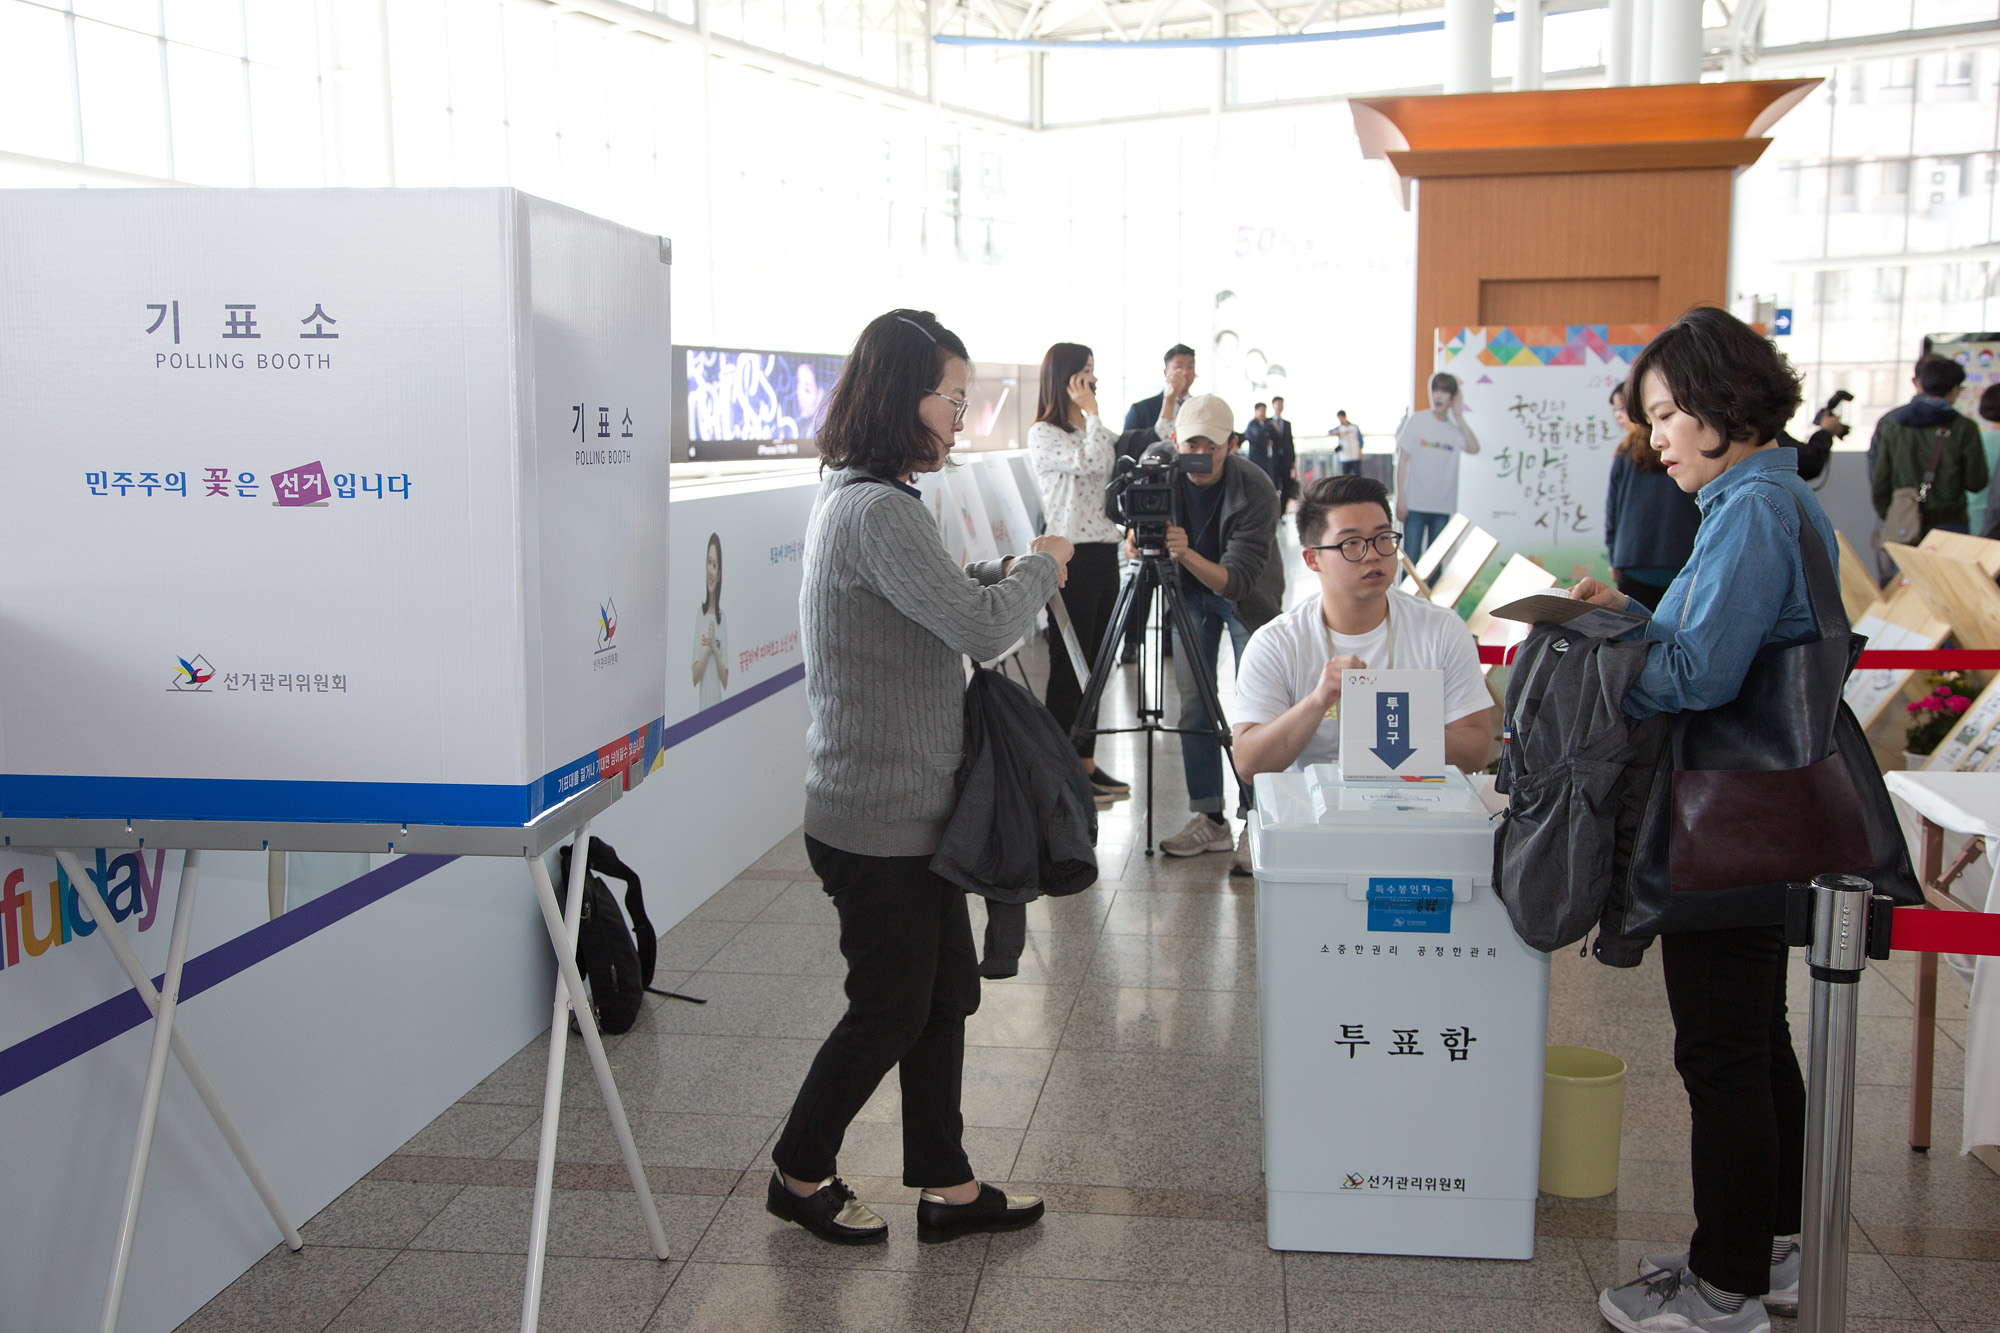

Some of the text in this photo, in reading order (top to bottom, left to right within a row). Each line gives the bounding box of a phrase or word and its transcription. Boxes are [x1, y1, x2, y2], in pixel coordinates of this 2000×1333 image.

[145, 300, 339, 344] 기표소
[156, 353, 331, 370] POLLING BOOTH
[572, 402, 634, 443] 기표소
[575, 449, 631, 466] POLLING BOOTH
[85, 467, 412, 500] 민주주의 꽃은 선거입니다
[223, 672, 347, 693] 선거관리위원회
[1386, 696, 1400, 745] 투입구
[1375, 884, 1431, 895] 특수봉인지
[0, 848, 166, 972] fulday
[1320, 944, 1496, 958] 소중한권리 공정한관리
[1334, 1024, 1477, 1062] 투표함
[1367, 1175, 1466, 1193] 선거관리위원회
